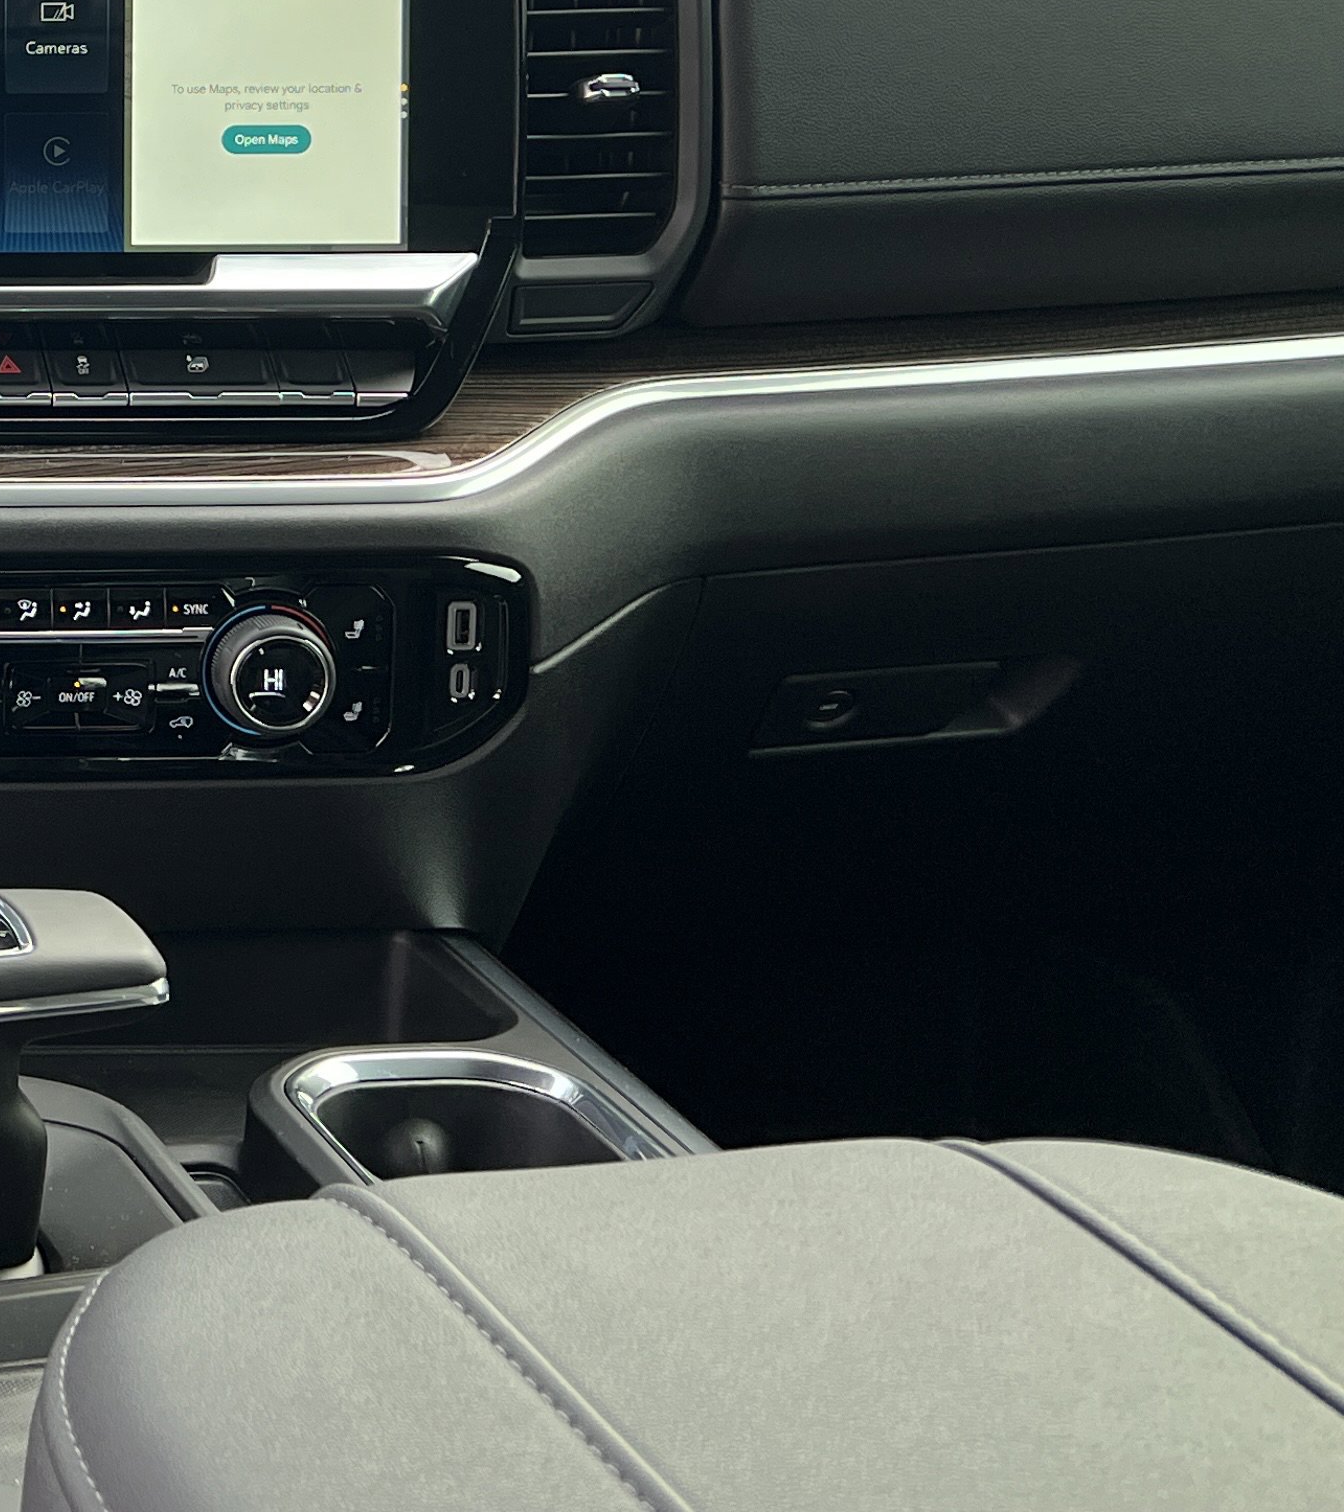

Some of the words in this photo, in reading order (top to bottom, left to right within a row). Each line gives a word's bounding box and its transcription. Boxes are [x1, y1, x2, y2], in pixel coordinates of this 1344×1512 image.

[26, 42, 88, 56] Cameras
[172, 84, 185, 94] To
[187, 86, 207, 94] use
[209, 84, 241, 96] Maps,
[244, 84, 279, 94] review
[281, 86, 305, 97] your
[308, 83, 351, 94] location
[354, 83, 363, 94] &
[224, 100, 263, 112] privacy
[266, 100, 309, 112] settings
[234, 134, 266, 147] Open
[268, 134, 299, 147] Maps
[10, 181, 49, 196] Apple
[53, 181, 105, 197] CarPlay
[183, 603, 209, 615] SYNC
[169, 667, 188, 679] A/C
[264, 668, 284, 691] HI
[59, 692, 95, 703] ON/OFF
